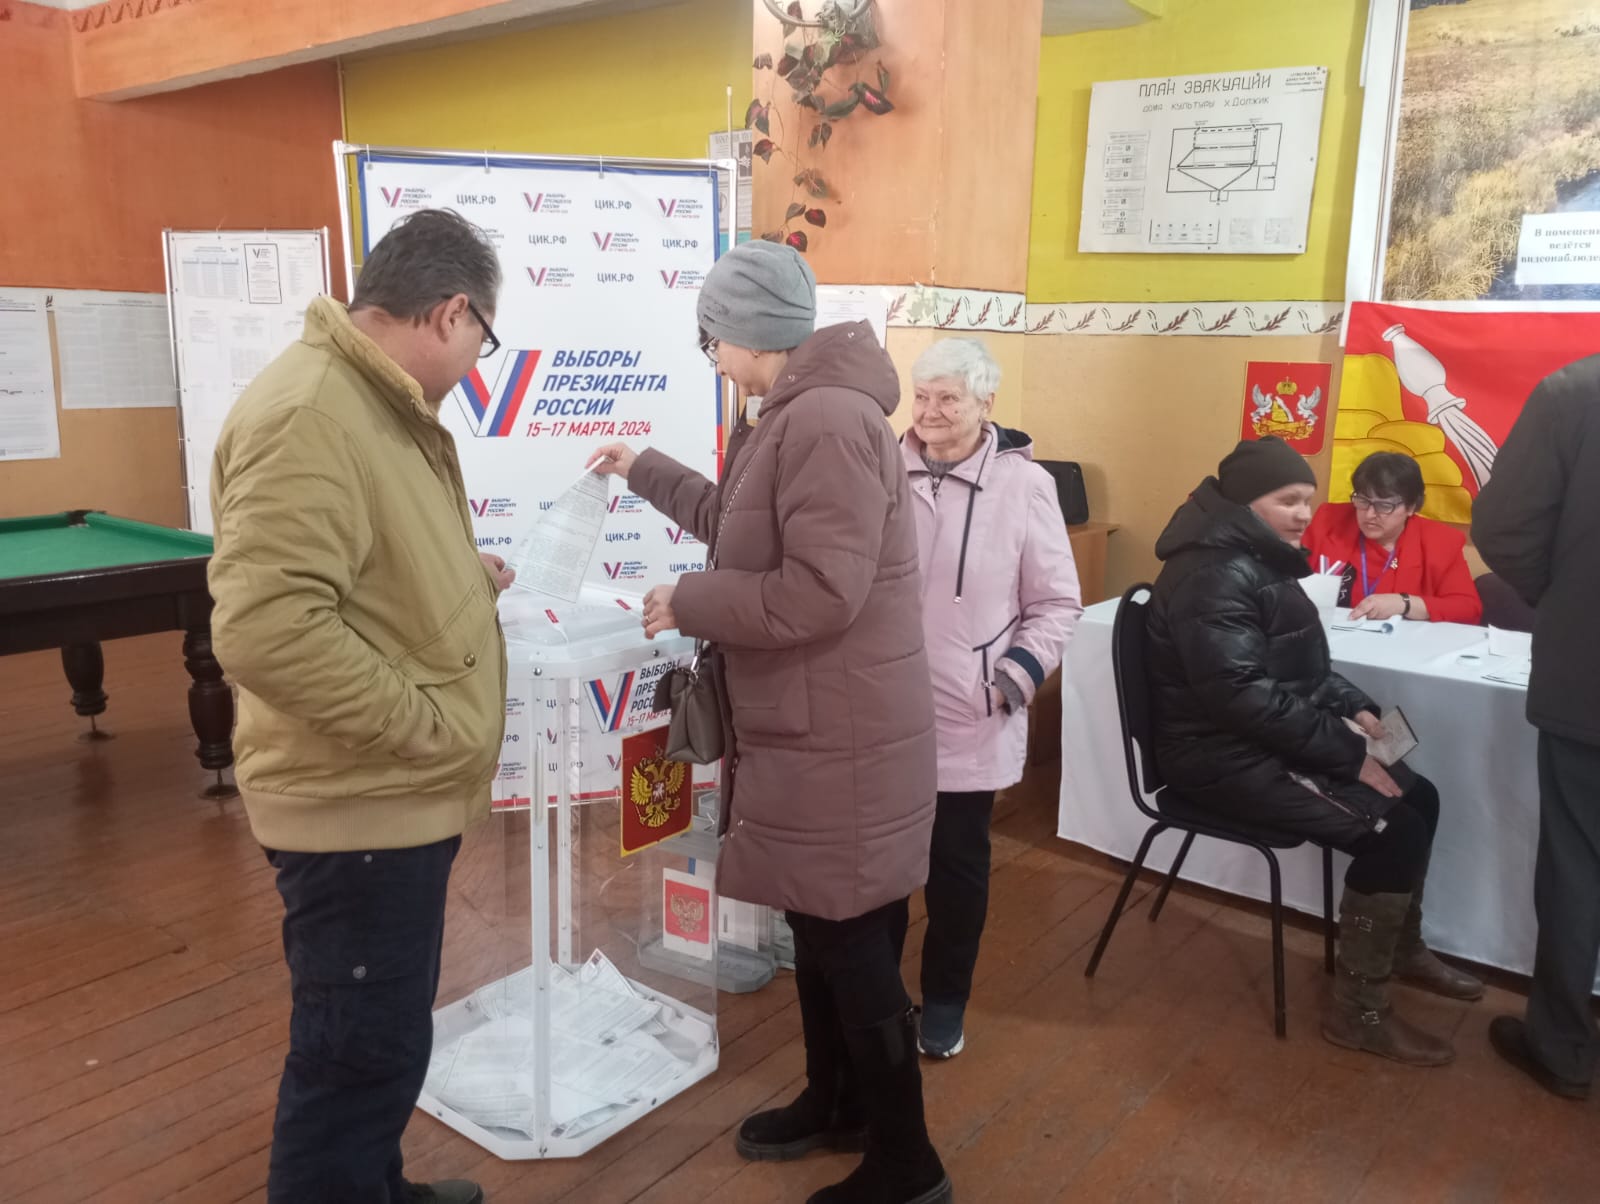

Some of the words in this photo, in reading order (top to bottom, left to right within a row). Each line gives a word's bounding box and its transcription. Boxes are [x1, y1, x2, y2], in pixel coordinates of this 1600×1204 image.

[1139, 81, 1176, 97] ПЛАН
[1184, 74, 1271, 94] ЭВАКУАЦИИ
[456, 194, 497, 206] ЦИК.РФ
[594, 199, 632, 210] ЦИК.РФ
[1535, 228, 1542, 237] В
[528, 234, 567, 246] ЦИК.РФ
[662, 238, 699, 249] ЦИК.РФ
[1521, 253, 1600, 263] видеонаблюде
[597, 272, 635, 284] ЦИК.РФ
[551, 350, 642, 368] ВЫБОРЫ
[542, 374, 668, 394] ПРЕЗИДЕНТА
[533, 398, 615, 416] РОССИИ
[567, 422, 616, 436] МАРТА
[617, 421, 652, 436] 2024
[474, 536, 512, 547] ЦИК.РФ
[605, 532, 641, 543] ЦИК.РФ
[669, 562, 704, 573] ЦИК.РФ
